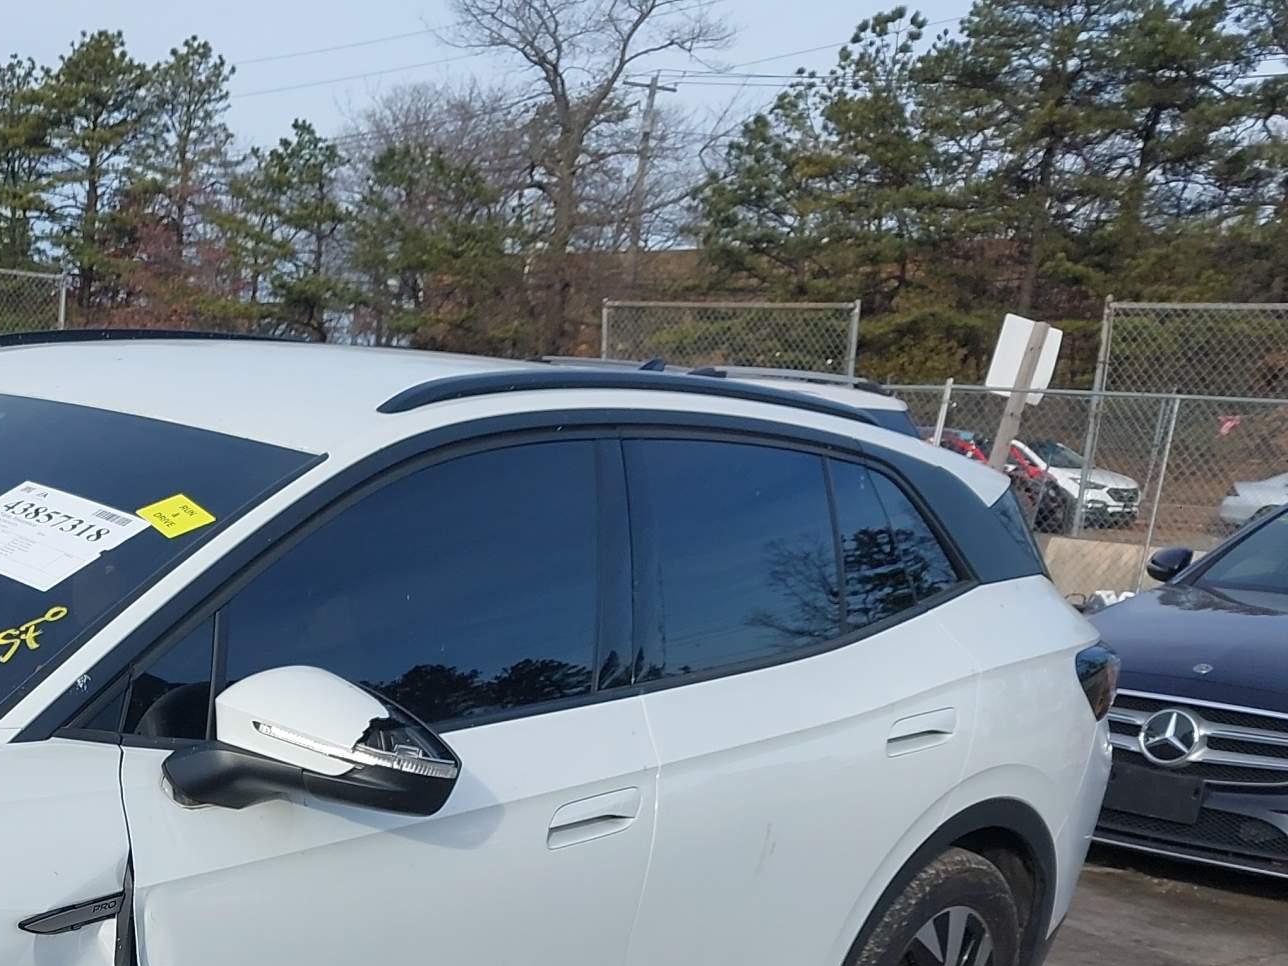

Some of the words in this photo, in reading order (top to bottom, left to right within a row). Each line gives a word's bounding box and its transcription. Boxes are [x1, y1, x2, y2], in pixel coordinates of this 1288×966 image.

[179, 504, 198, 517] RUN
[3, 500, 111, 542] 43857318
[152, 512, 176, 528] DRIVE
[92, 900, 117, 913] PRO
